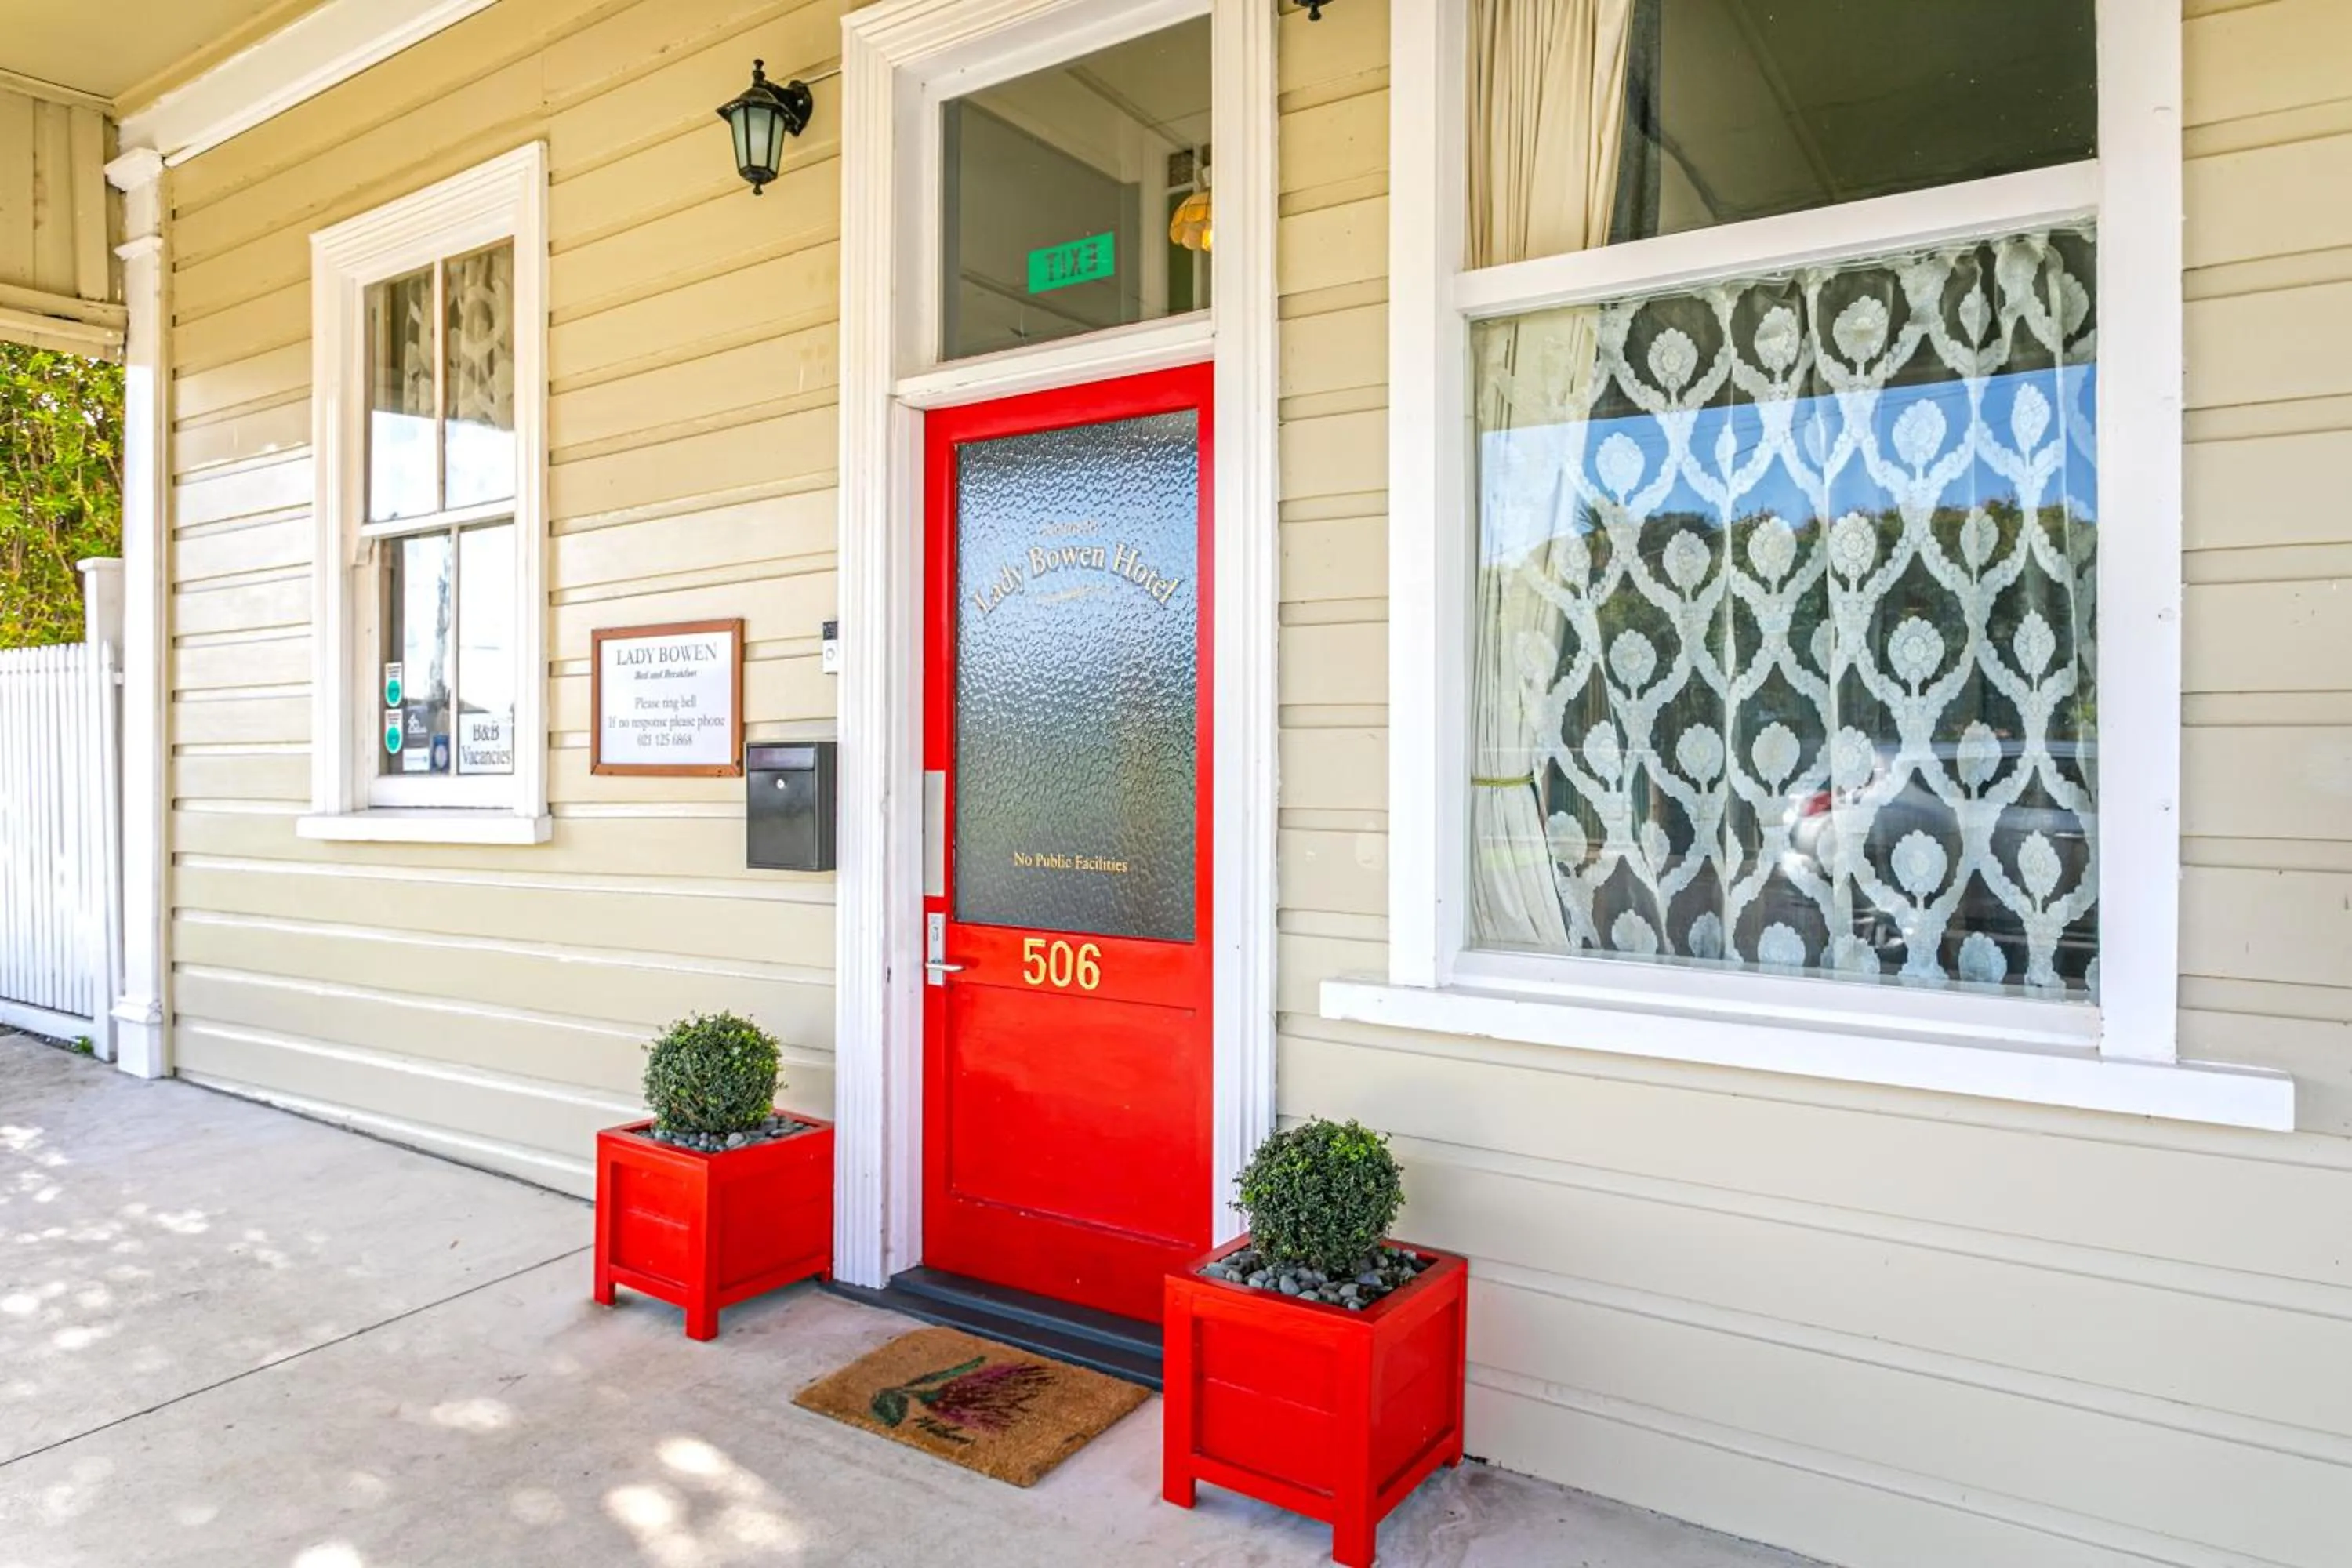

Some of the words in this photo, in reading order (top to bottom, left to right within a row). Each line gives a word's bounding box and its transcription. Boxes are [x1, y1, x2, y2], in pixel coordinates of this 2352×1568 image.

[973, 561, 1025, 615] Lady
[1026, 545, 1106, 579] Bowen
[1110, 542, 1179, 607] Hotel
[616, 648, 655, 666] LADY
[659, 643, 717, 662] BOWEN
[650, 670, 663, 679] and
[634, 697, 660, 710] Please
[662, 697, 680, 713] ring
[680, 694, 697, 709] bell
[472, 723, 500, 741] B&B
[608, 715, 618, 729] If
[619, 718, 630, 728] no
[632, 719, 667, 731] response
[670, 715, 695, 731] please
[698, 714, 725, 731] phone
[460, 745, 511, 766] Vacancies
[1014, 851, 1033, 867] No
[1036, 851, 1072, 869] Public
[1075, 854, 1129, 873] Facilities
[1022, 938, 1102, 991] 506
